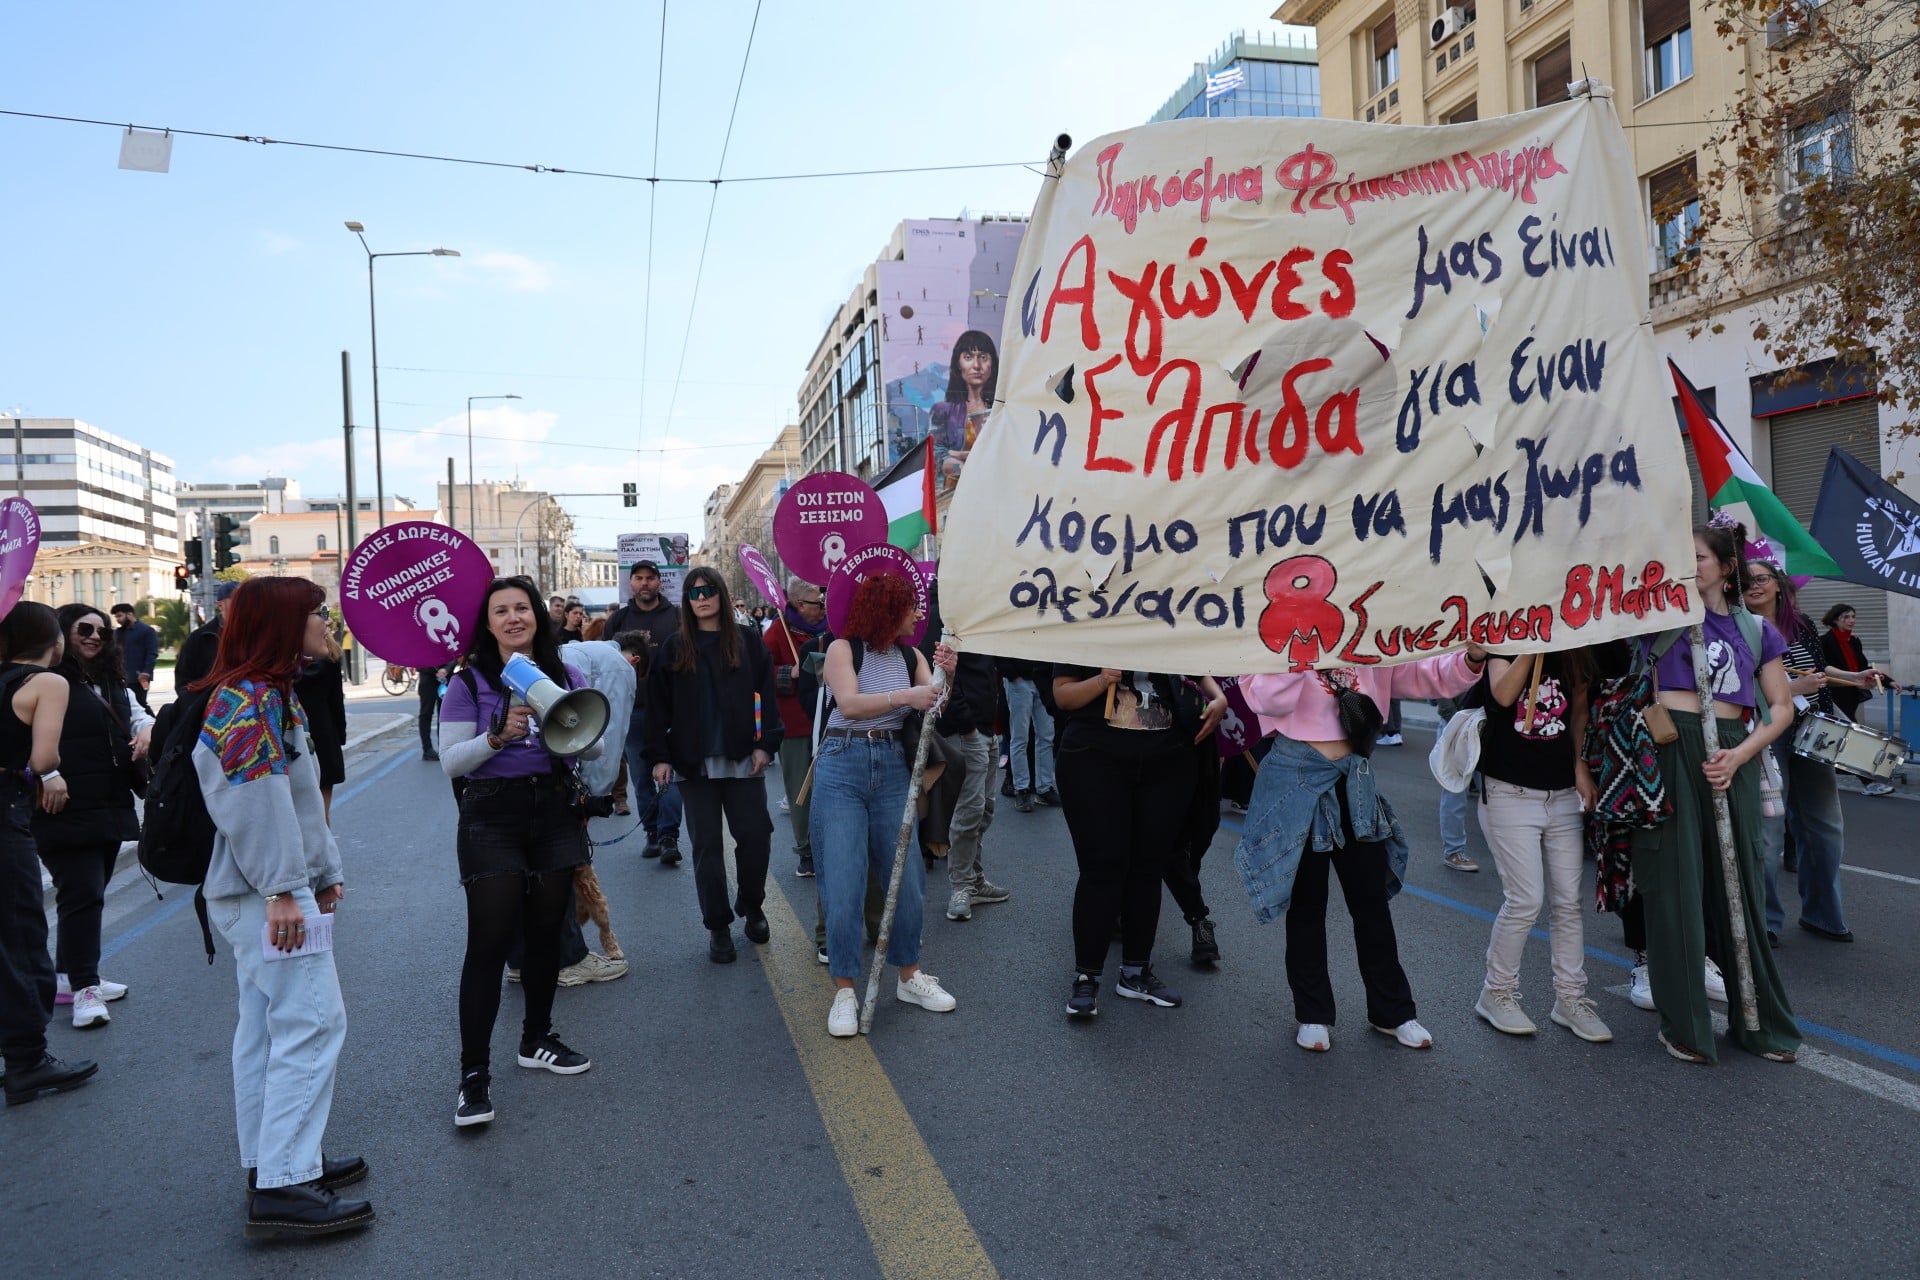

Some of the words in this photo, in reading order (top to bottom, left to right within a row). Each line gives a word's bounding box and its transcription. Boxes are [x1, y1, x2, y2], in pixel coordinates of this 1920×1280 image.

[1092, 142, 1262, 234] Παγκόσμια
[1040, 234, 1356, 376] Αγώνες
[1405, 225, 1502, 320] μας
[1033, 410, 1067, 467] η
[1396, 360, 1481, 453] για
[10, 501, 37, 545] ΠΡΟΣΤΑΣΙΑ
[797, 492, 822, 506] ΟΧΙ
[826, 491, 865, 505] ΣΤΟΝ
[799, 509, 863, 524] ΣΕΞΙΣΜΟ
[1227, 503, 1327, 558] που
[1352, 489, 1406, 542] να
[1430, 470, 1510, 566] μας
[346, 532, 395, 600] ΔΗΜΟΣΙΕΣ
[397, 526, 463, 550] ΔΩΡΕΑΝ
[365, 549, 451, 600] ΚΟΙΝΩΝΙΚΕΣ
[842, 546, 895, 575] ΣΕΒΑΣΜΟΣ
[1856, 522, 1896, 578] HUMAN
[379, 566, 455, 610] ΥΠΗΡΕΣΙΕΣ
